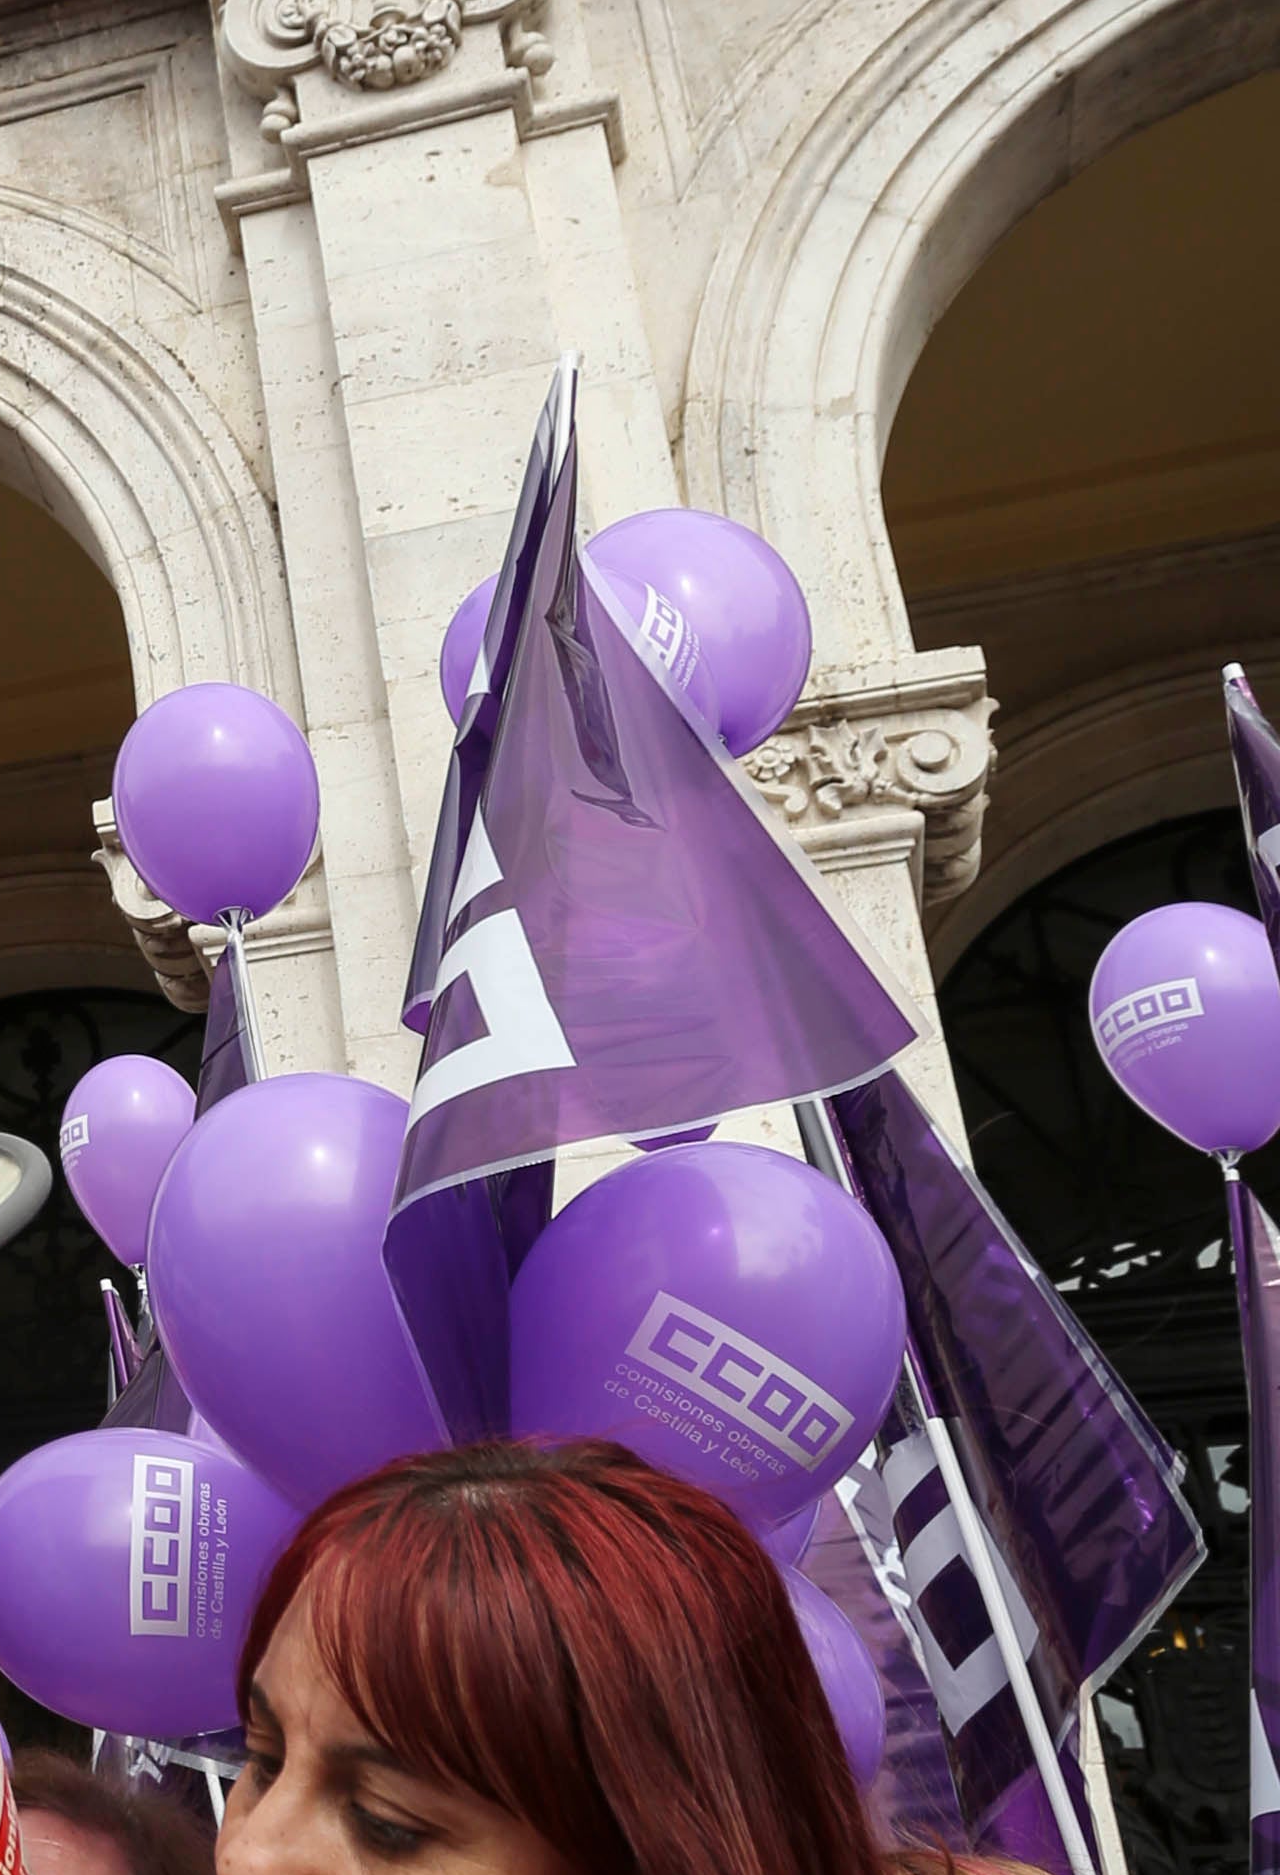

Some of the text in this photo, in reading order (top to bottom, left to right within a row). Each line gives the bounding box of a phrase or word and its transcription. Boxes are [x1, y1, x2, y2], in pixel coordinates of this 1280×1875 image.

[1097, 984, 1195, 1049] CCOO
[604, 1378, 761, 1481] de Castilla y León
[614, 1362, 787, 1476] comisiones obreras
[644, 1308, 844, 1461] CCOO
[139, 1461, 184, 1624] CCOO
[195, 1482, 211, 1638] comisiones obreras
[213, 1498, 228, 1535] León
[213, 1538, 230, 1550] y
[210, 1553, 226, 1614] Castilla
